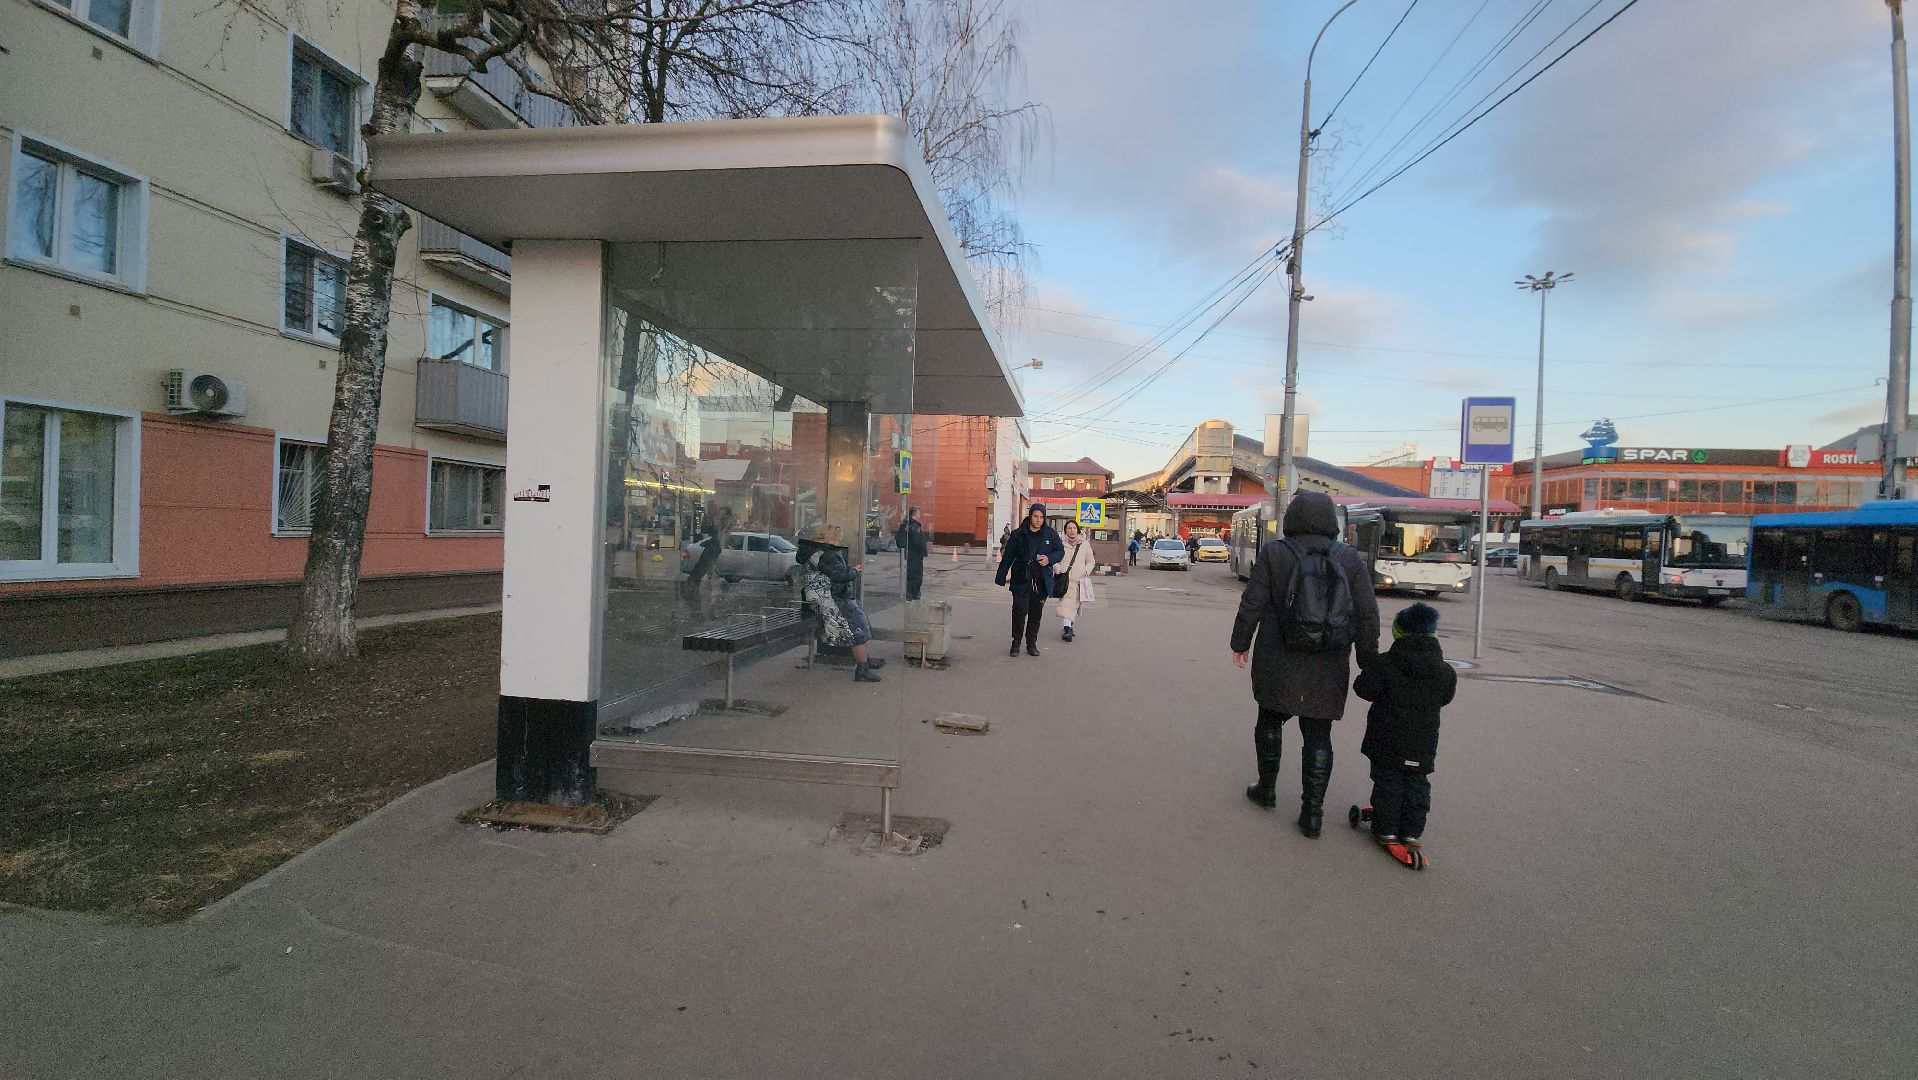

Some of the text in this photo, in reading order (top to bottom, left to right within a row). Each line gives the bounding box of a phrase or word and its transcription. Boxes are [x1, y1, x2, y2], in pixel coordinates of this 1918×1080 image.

[1623, 449, 1689, 461] SPAR
[1823, 454, 1875, 465] ROSTI
[1460, 464, 1503, 472] ROSTC'S
